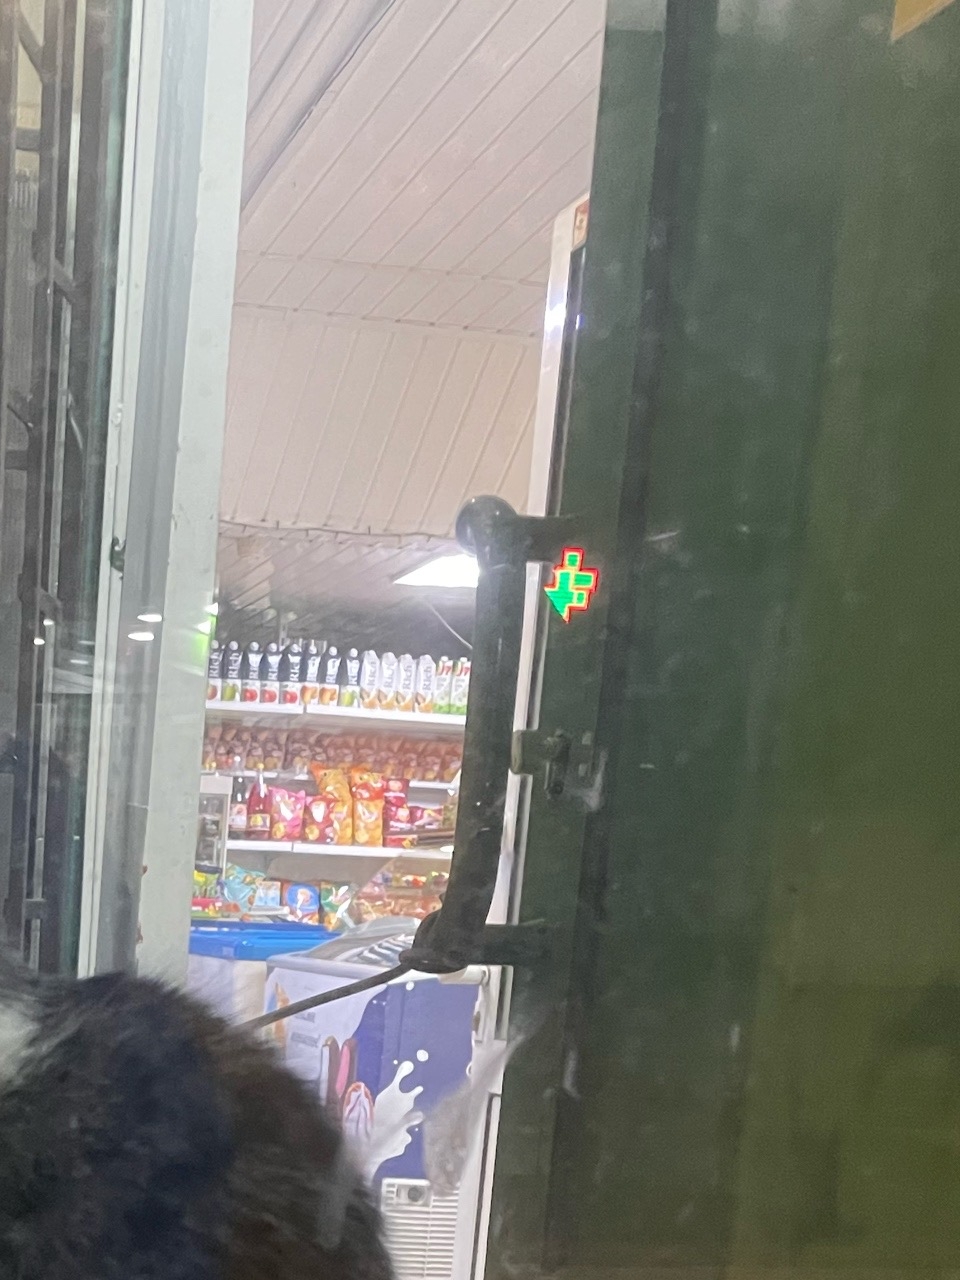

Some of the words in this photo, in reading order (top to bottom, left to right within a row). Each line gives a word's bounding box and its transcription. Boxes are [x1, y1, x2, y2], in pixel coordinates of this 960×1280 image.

[228, 652, 239, 678] Rich
[402, 665, 412, 690] Rich
[422, 666, 432, 690] Rich
